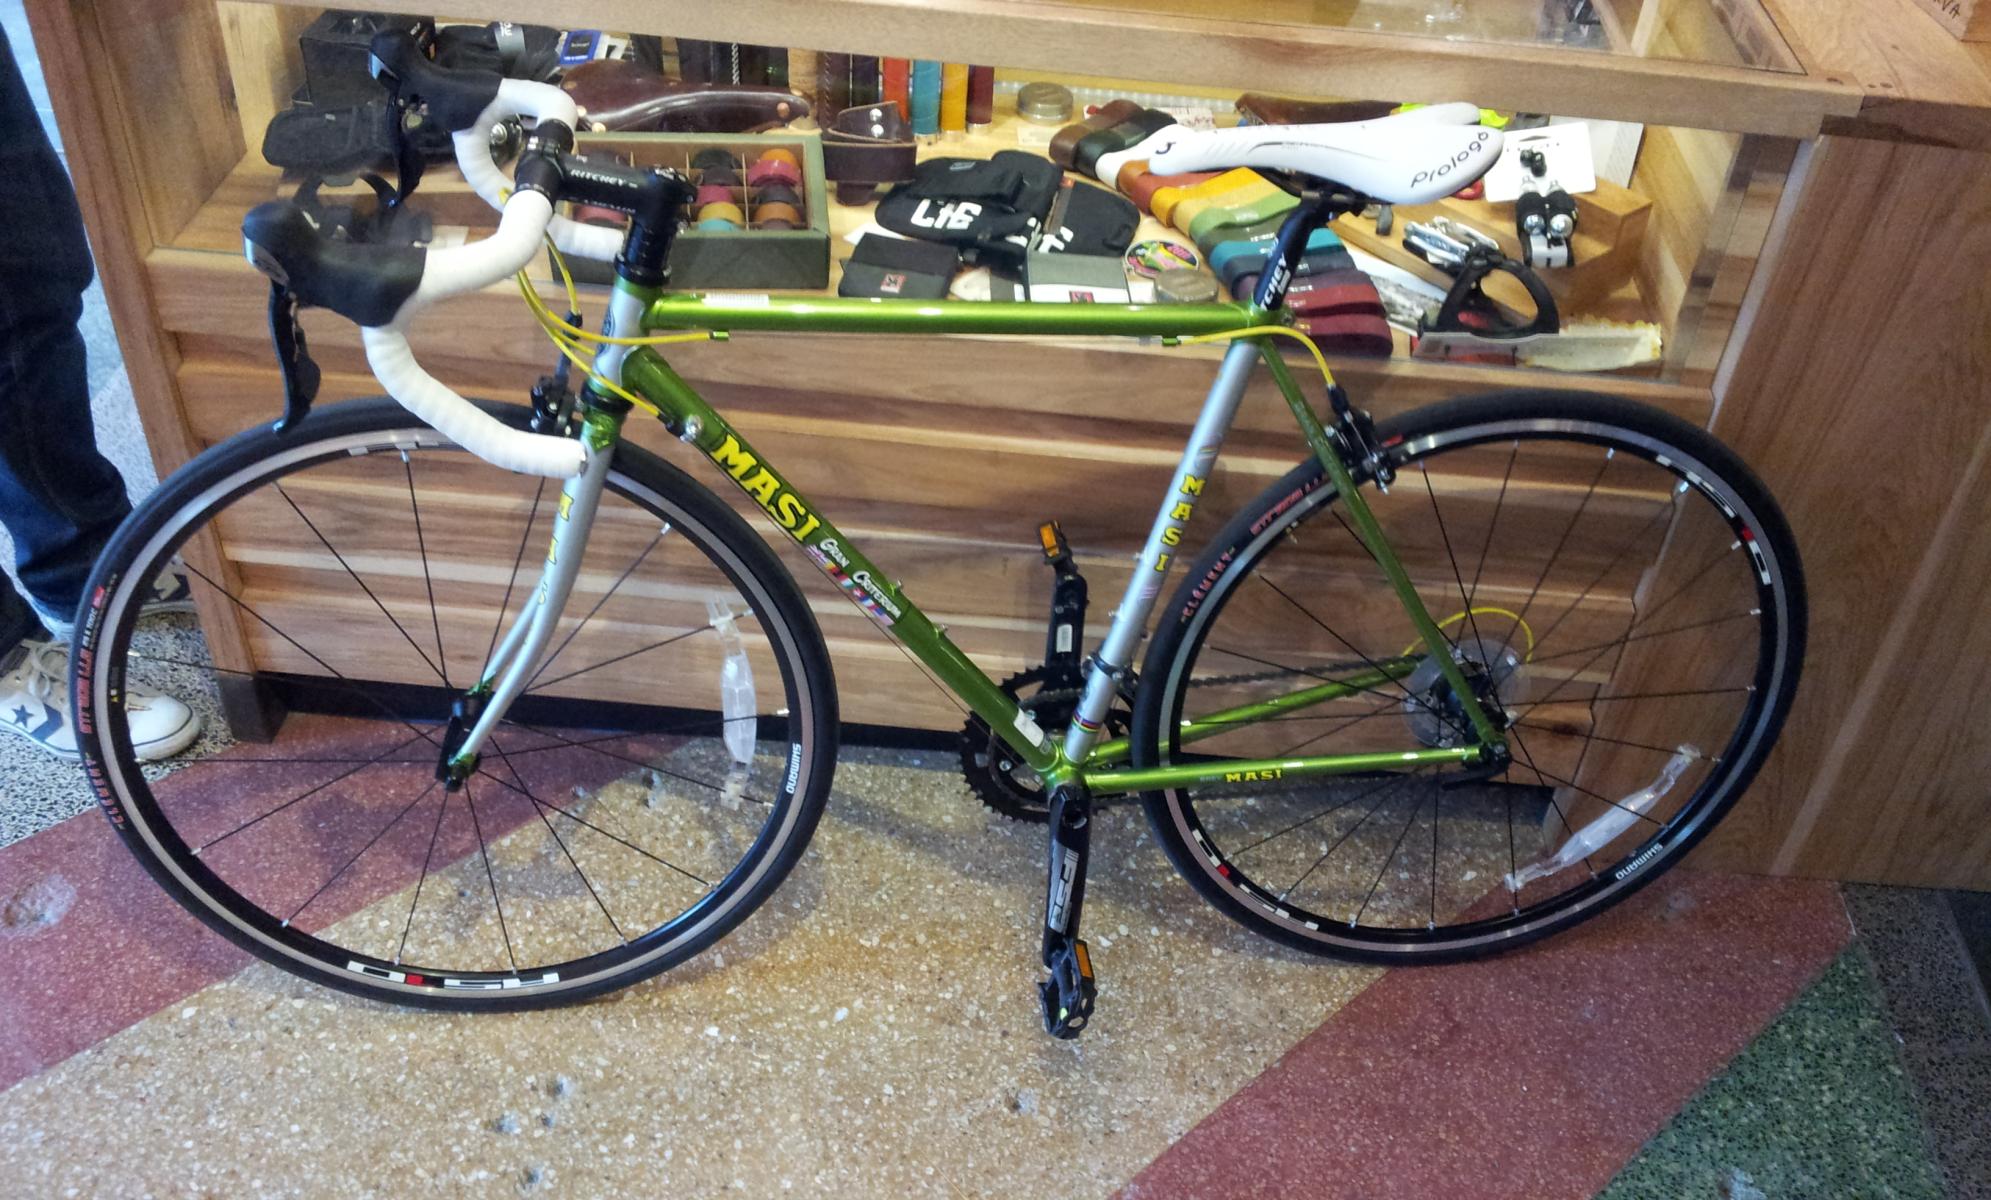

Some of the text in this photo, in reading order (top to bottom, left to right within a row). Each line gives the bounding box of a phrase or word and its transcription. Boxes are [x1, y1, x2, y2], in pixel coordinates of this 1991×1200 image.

[570, 168, 626, 188] RITCHEY
[711, 434, 820, 541] MASI
[1154, 474, 1206, 572] MASI
[820, 538, 901, 618] GRAN CRITERIUM
[785, 742, 802, 795] SHIMANO
[1225, 769, 1283, 783] MASI
[1615, 843, 1664, 880] SHIMANO
